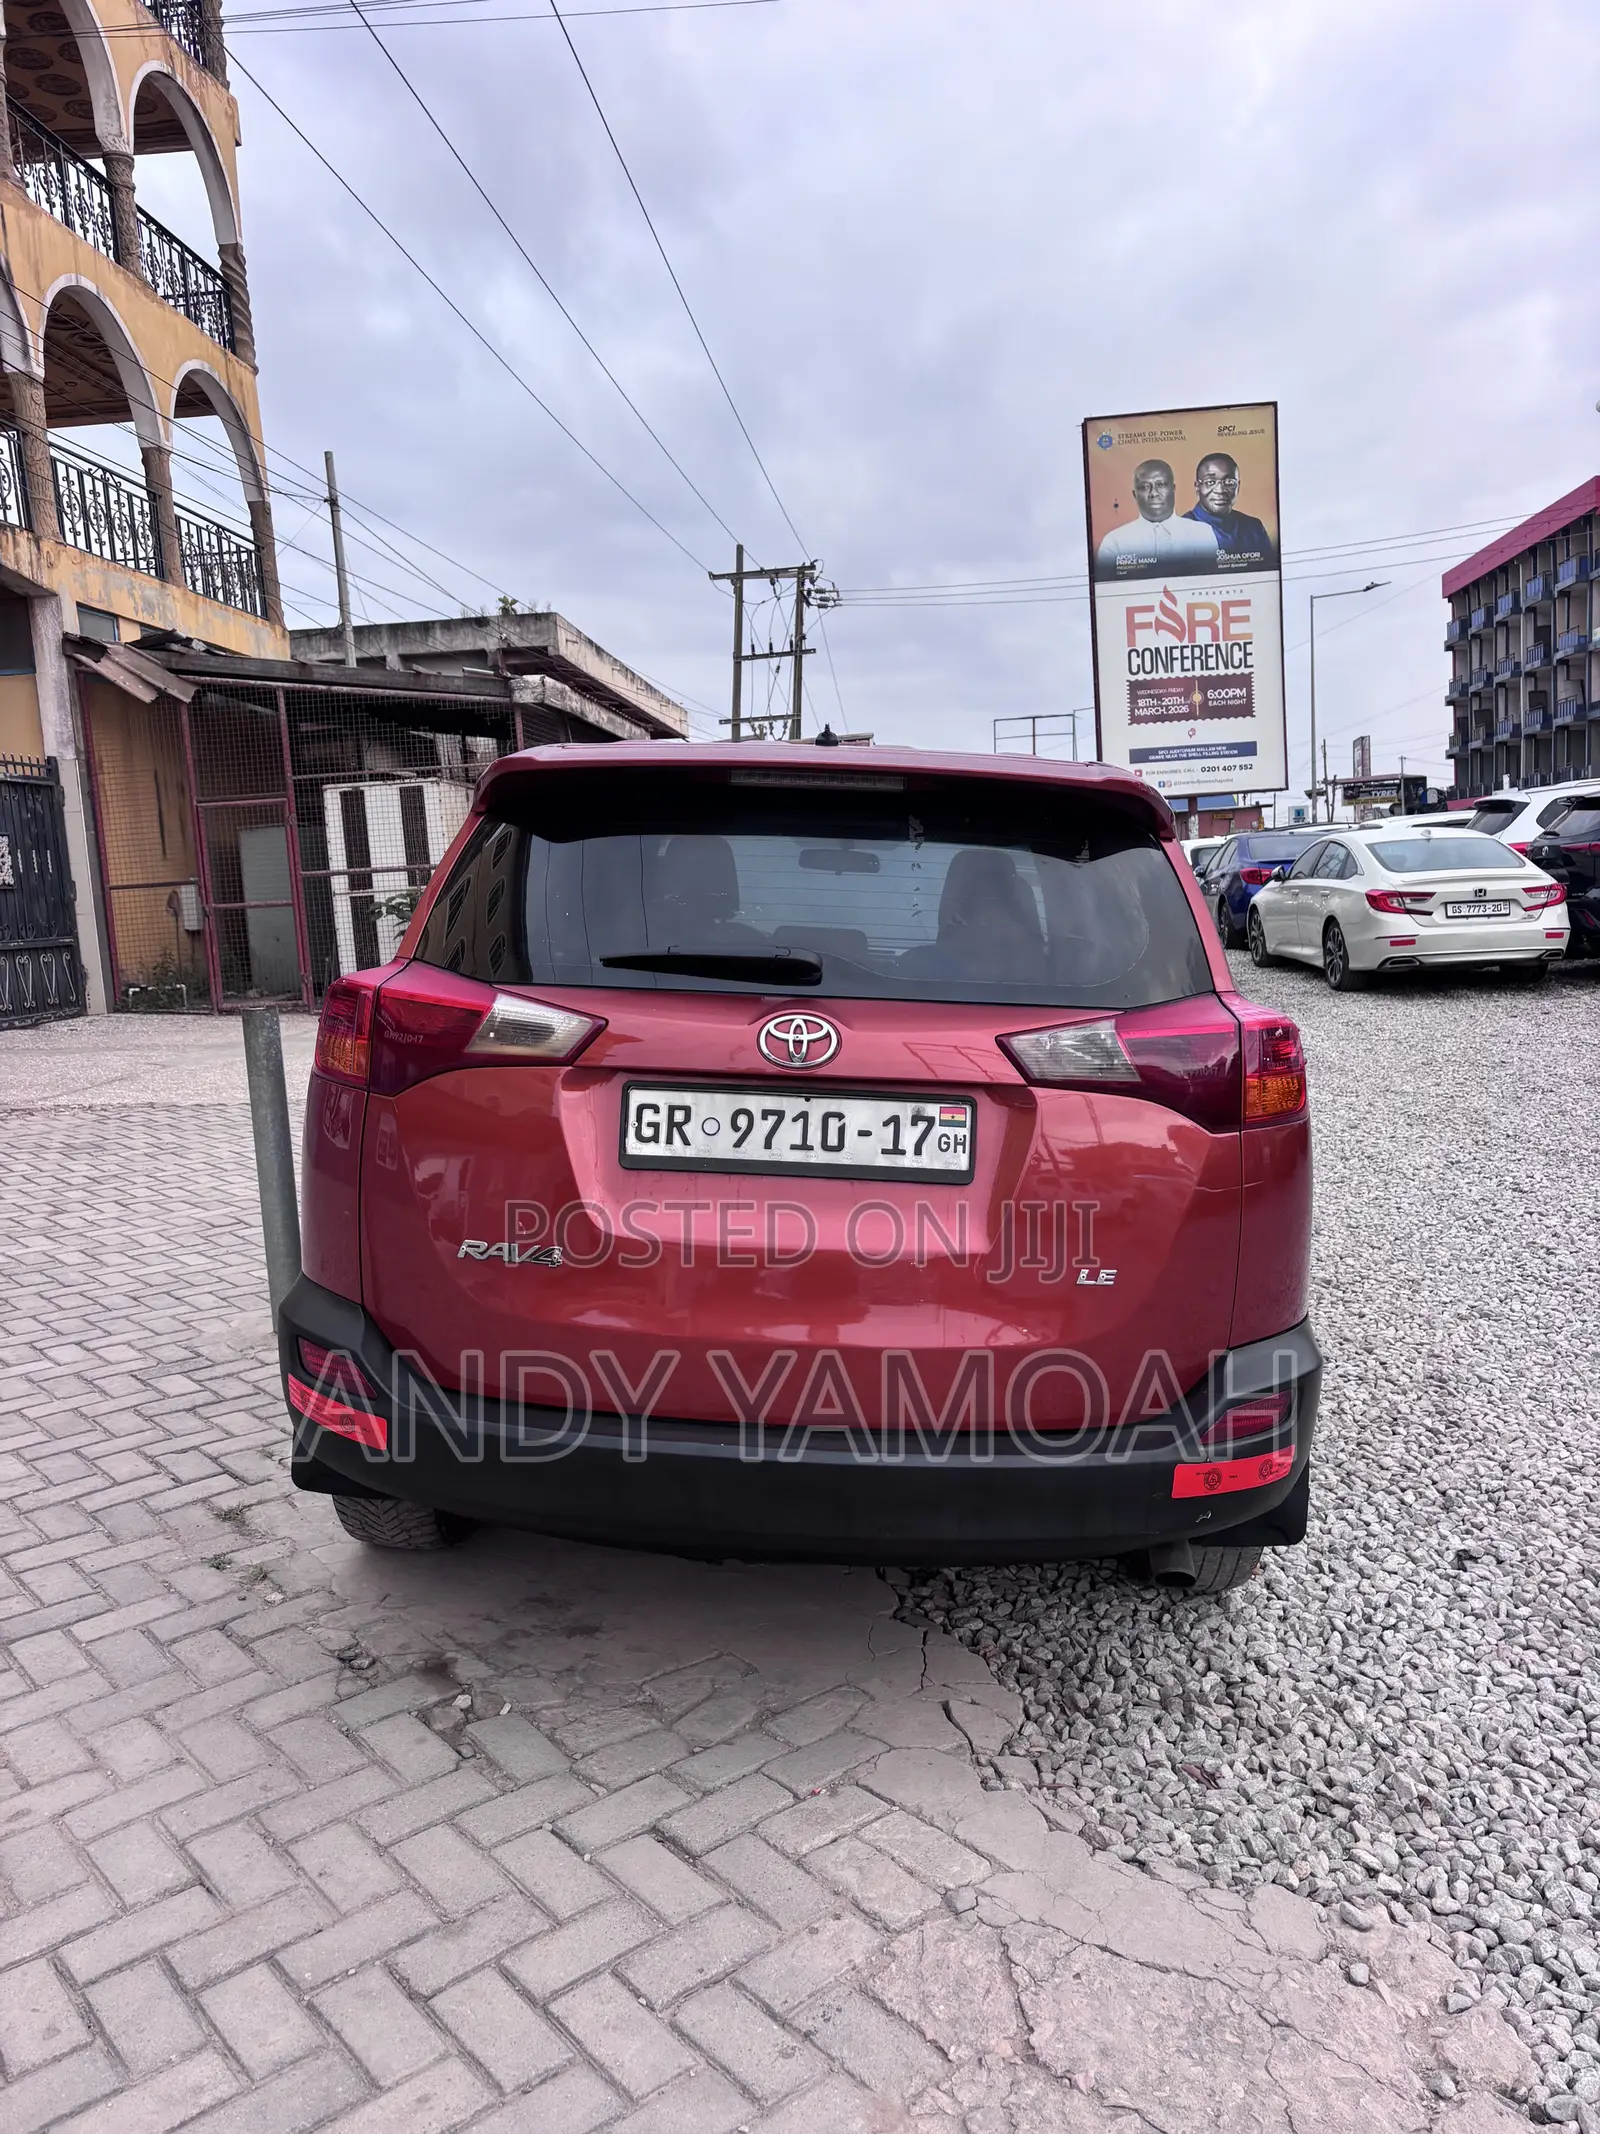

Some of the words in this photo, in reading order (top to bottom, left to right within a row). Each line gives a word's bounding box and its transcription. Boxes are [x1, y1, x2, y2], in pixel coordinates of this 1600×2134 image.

[1128, 641, 1254, 675] CONFERENCE
[1207, 688, 1246, 699] 6:00PM
[1168, 705, 1189, 714] 2026
[1201, 765, 1220, 773] 0201
[1452, 905, 1462, 914] GS
[1466, 903, 1502, 913] 7773-20
[636, 1104, 692, 1146] GR
[937, 1133, 967, 1155] GH
[457, 1239, 563, 1267] RAV4
[1075, 1268, 1118, 1286] LE
